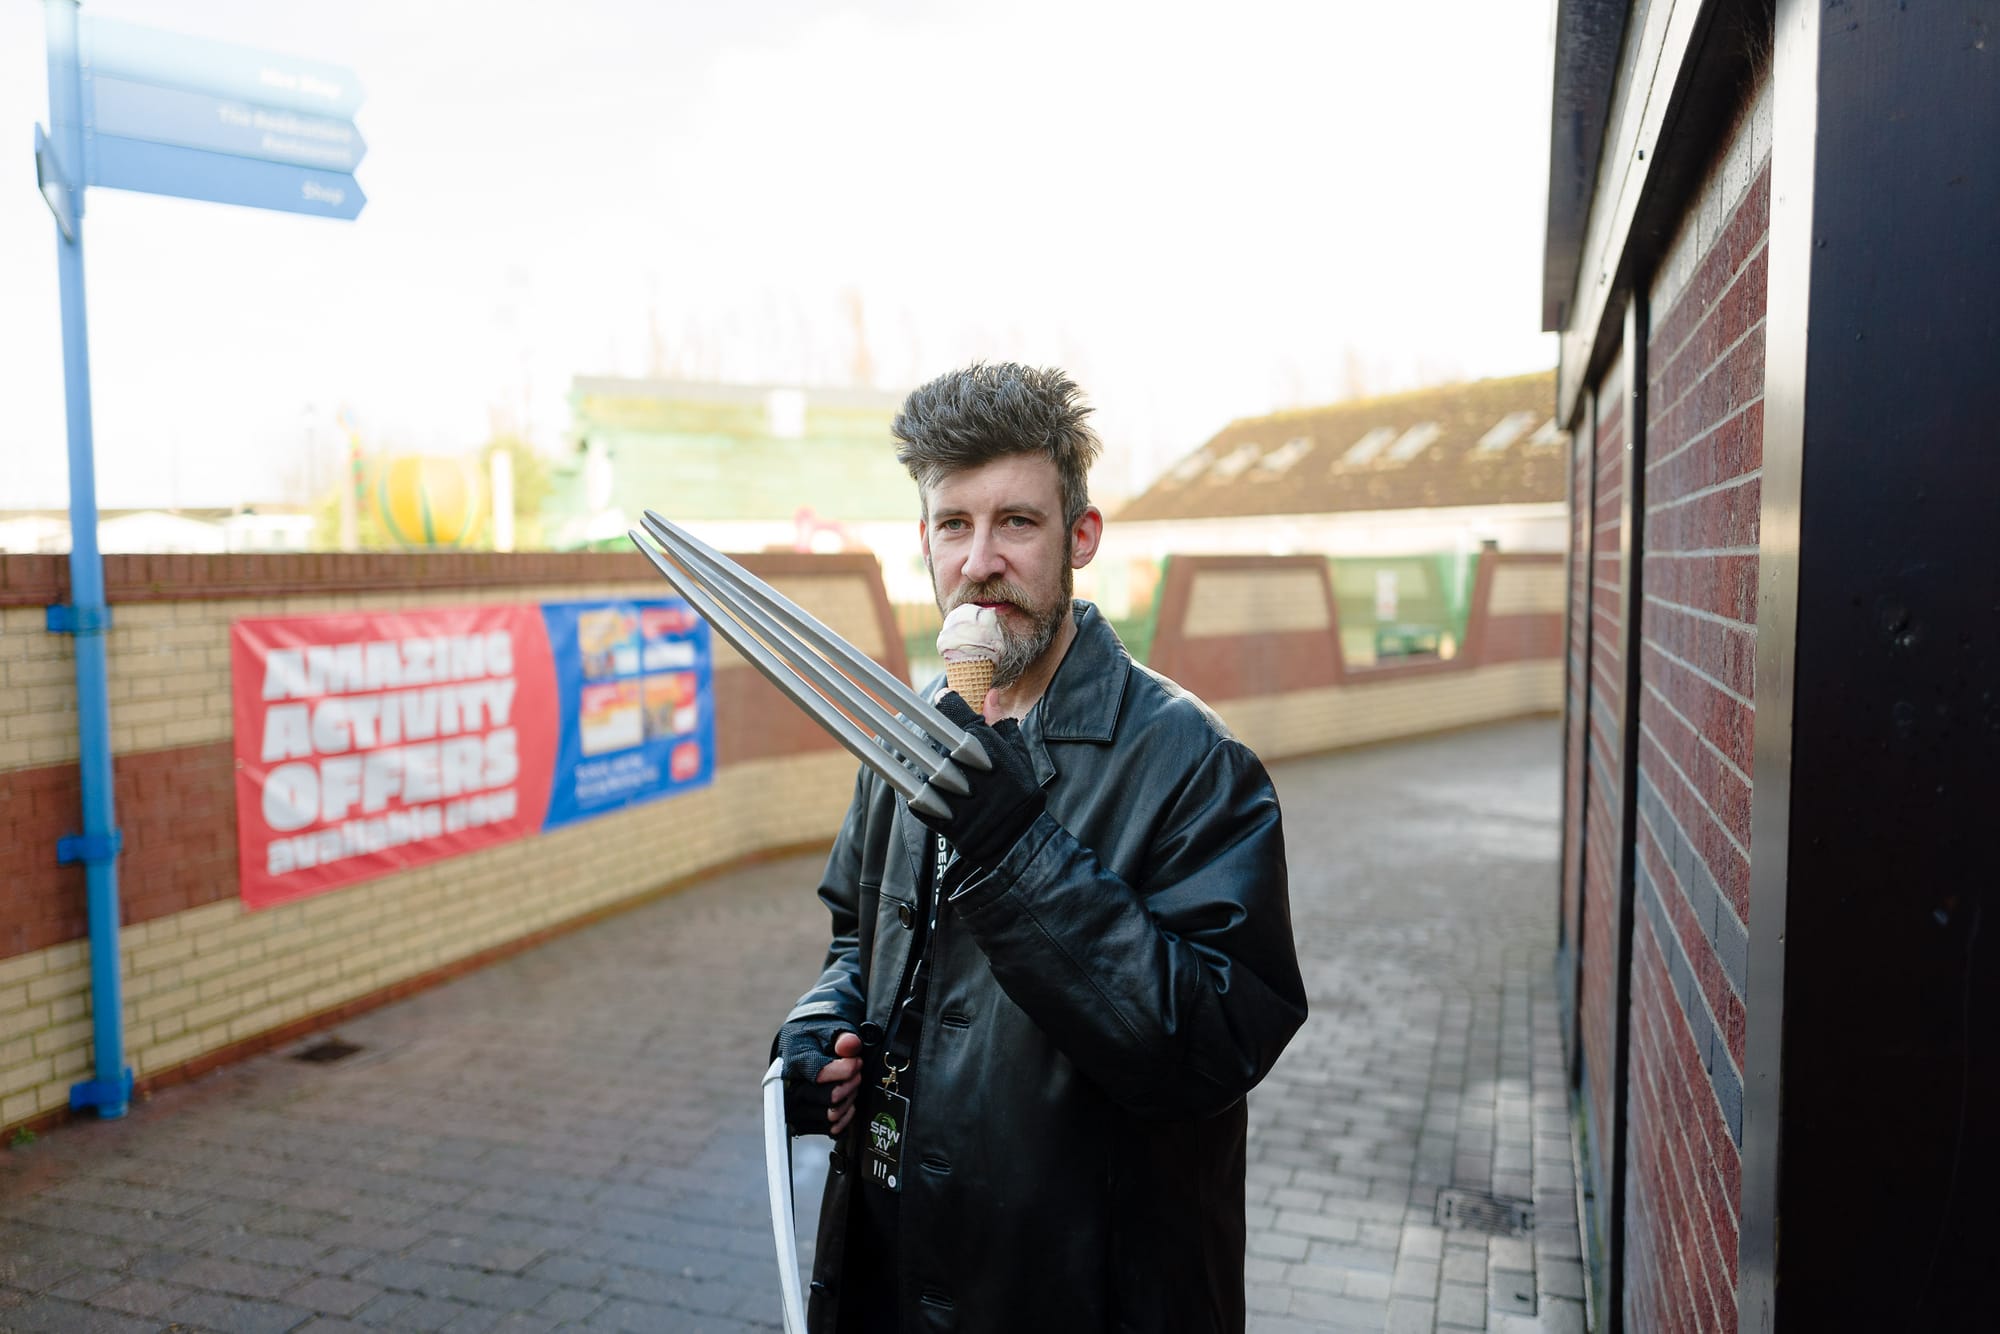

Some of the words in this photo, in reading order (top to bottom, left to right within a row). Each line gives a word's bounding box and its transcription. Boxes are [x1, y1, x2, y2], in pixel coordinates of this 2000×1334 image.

[262, 631, 514, 701] AMAZING
[261, 679, 517, 762] ACTIVITY
[262, 728, 519, 831] OFFERS
[267, 804, 443, 876] available
[444, 788, 518, 833] now
[936, 834, 947, 880] DER
[870, 1121, 900, 1144] SFW
[875, 1136, 891, 1151] XV
